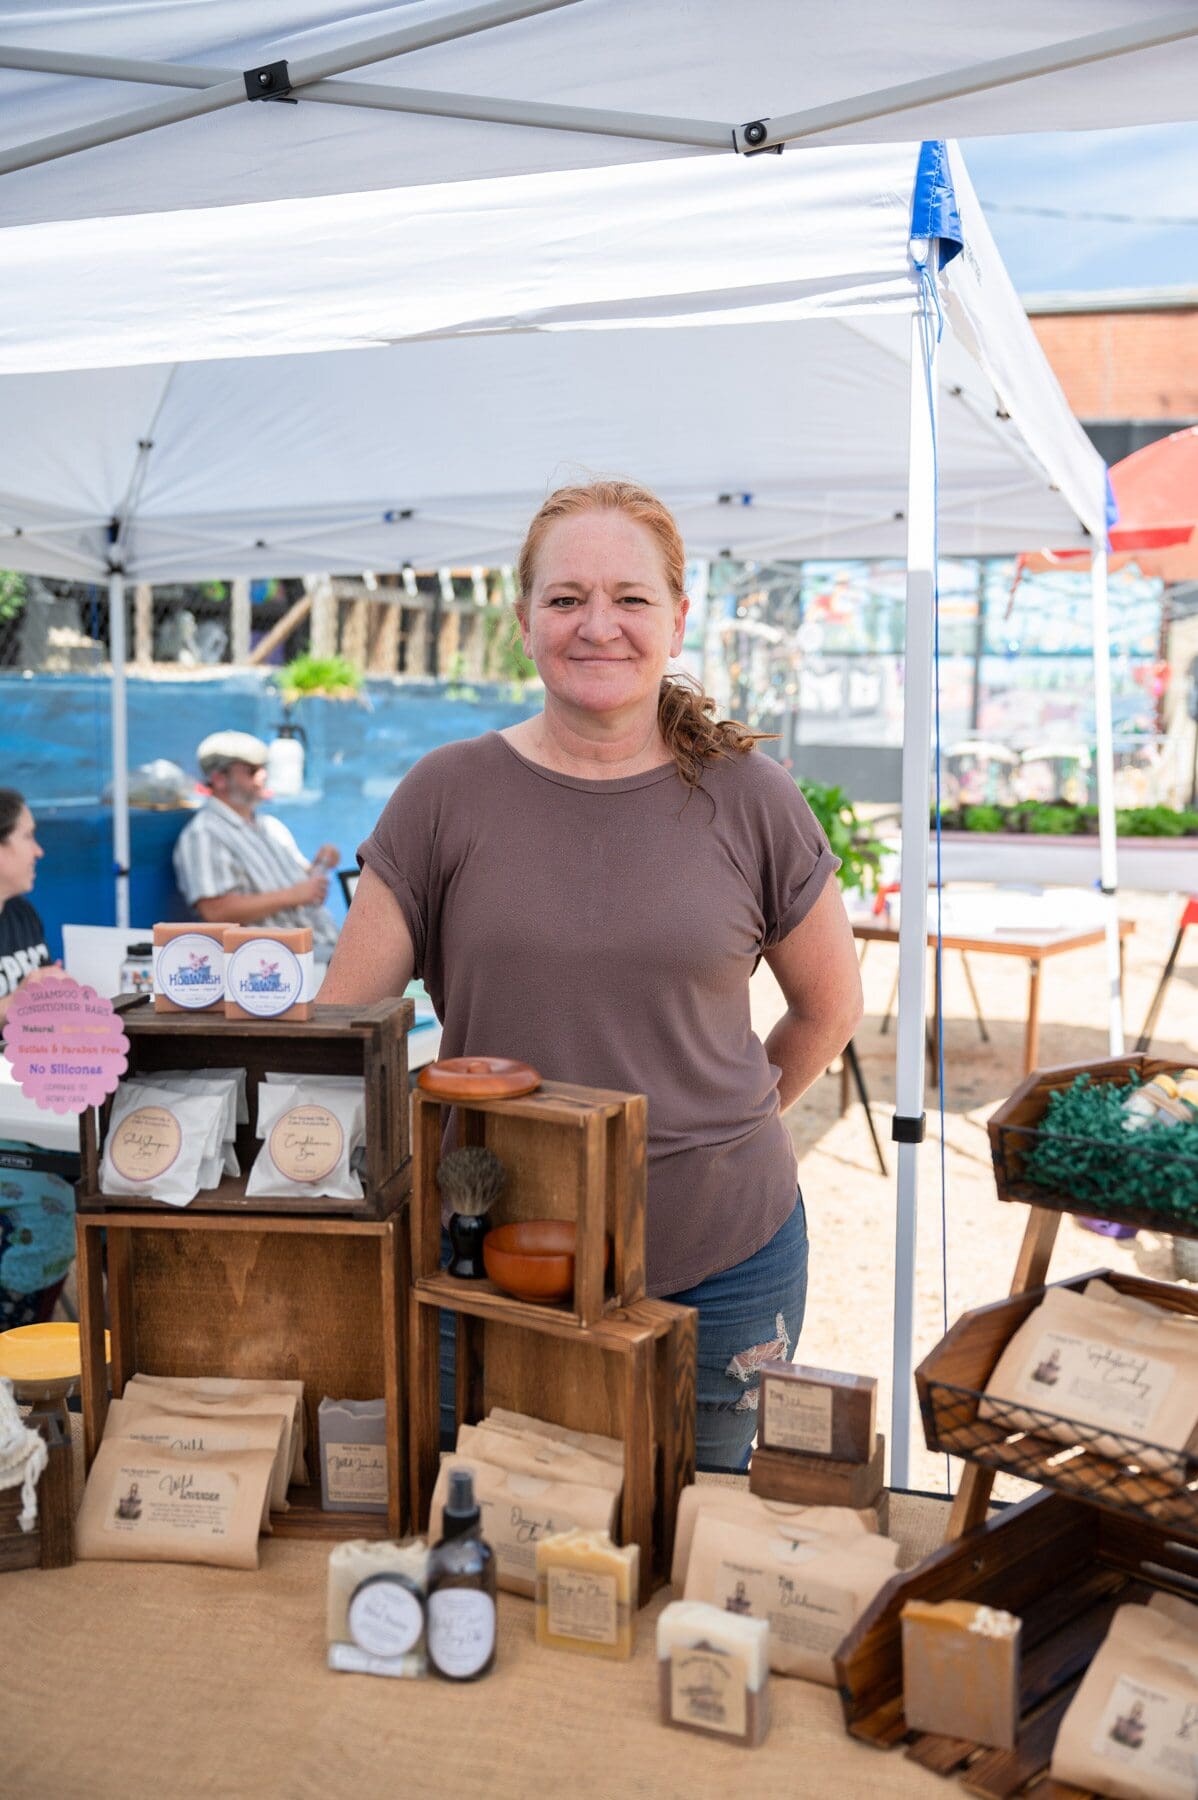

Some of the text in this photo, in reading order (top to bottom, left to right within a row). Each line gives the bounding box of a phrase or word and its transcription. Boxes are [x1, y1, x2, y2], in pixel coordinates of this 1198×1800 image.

[31, 990, 79, 1001] SHAMPOO
[17, 1003, 81, 1016] CONDITIONER
[22, 1025, 54, 1033] Natural
[29, 1064, 103, 1075] No Silicones
[159, 1474, 194, 1496] Wild
